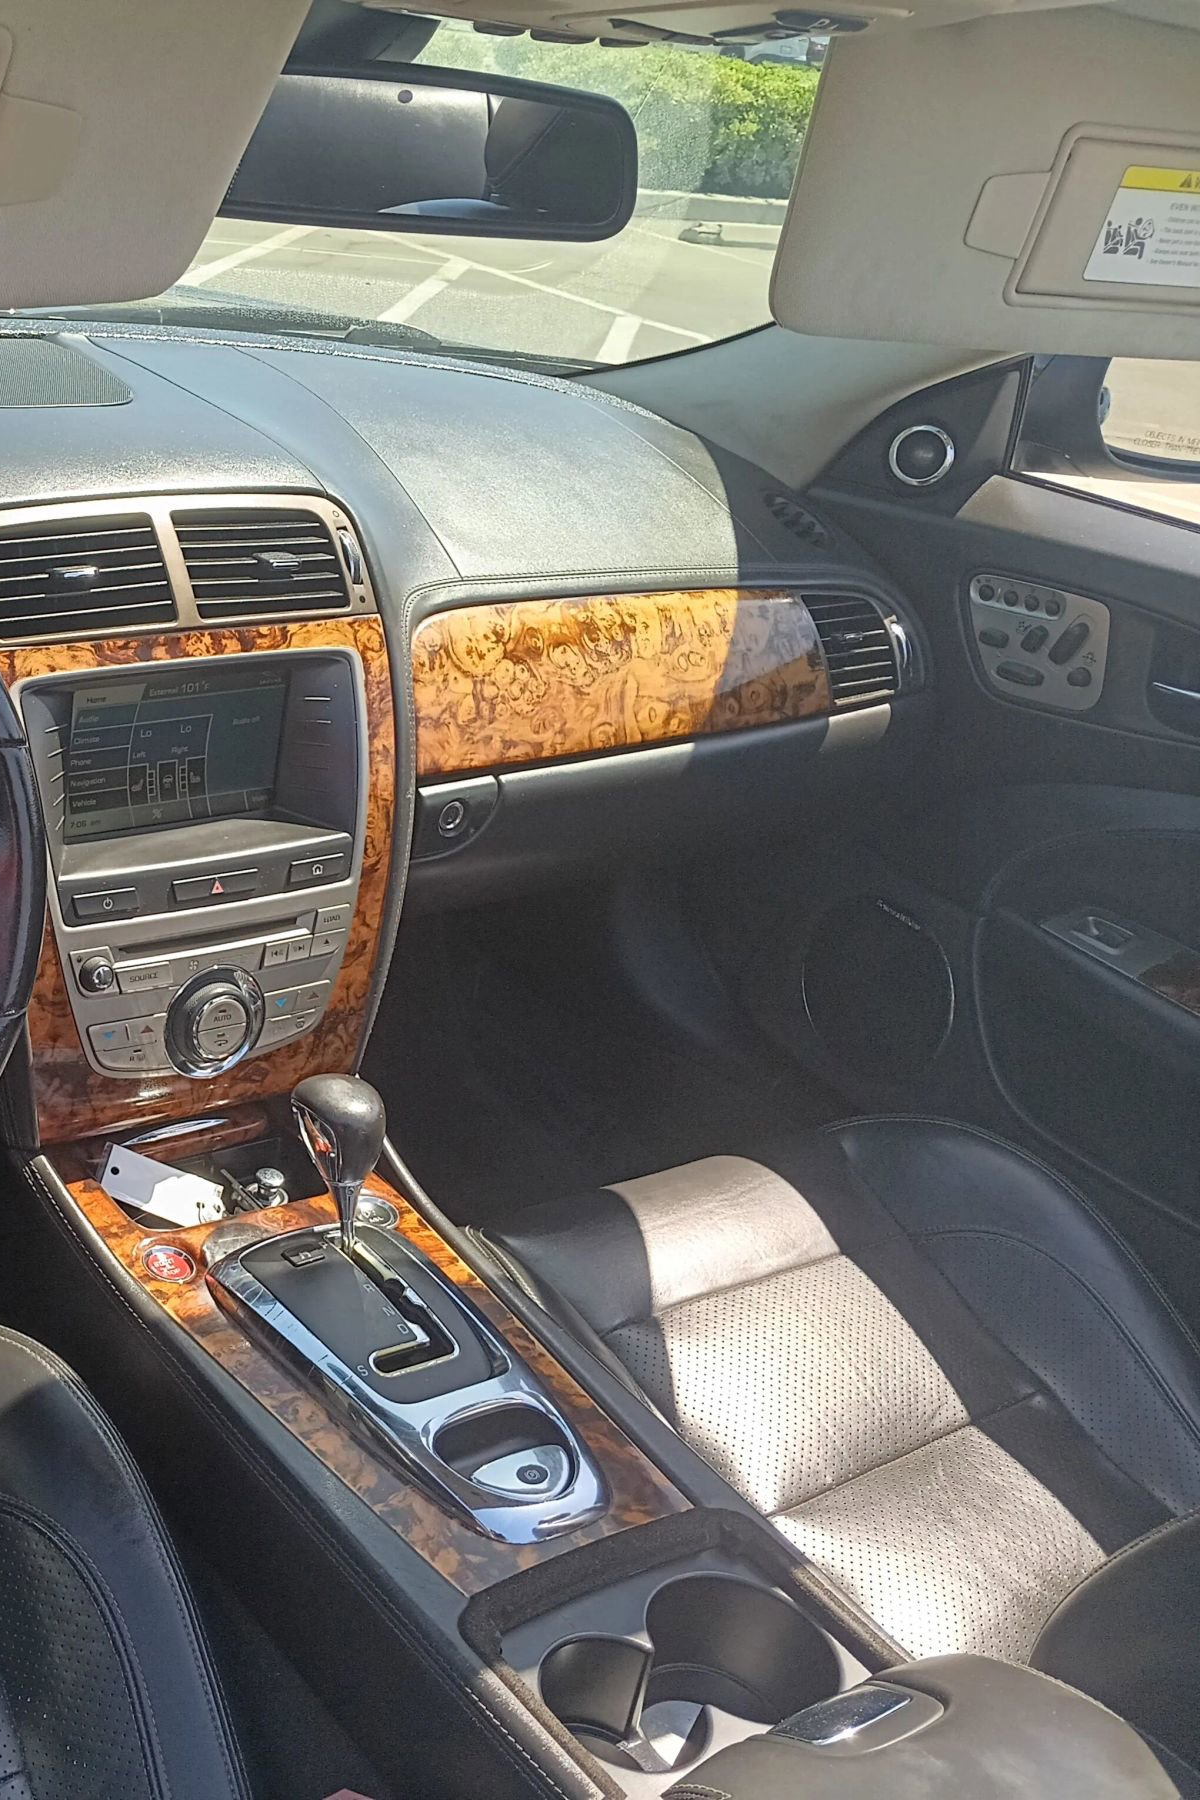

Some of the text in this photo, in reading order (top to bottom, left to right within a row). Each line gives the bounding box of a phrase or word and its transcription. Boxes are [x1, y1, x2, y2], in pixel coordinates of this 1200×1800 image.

[140, 724, 192, 738] Lo Lo
[73, 736, 100, 745] Climate
[132, 751, 146, 759] Left
[70, 759, 93, 767] Phone
[70, 777, 106, 788] Navigation
[72, 799, 97, 808] Vehicle
[129, 972, 158, 983] SOURCE
[213, 1014, 232, 1023] AUTO
[396, 1323, 409, 1335] D
[356, 1364, 369, 1377] S
